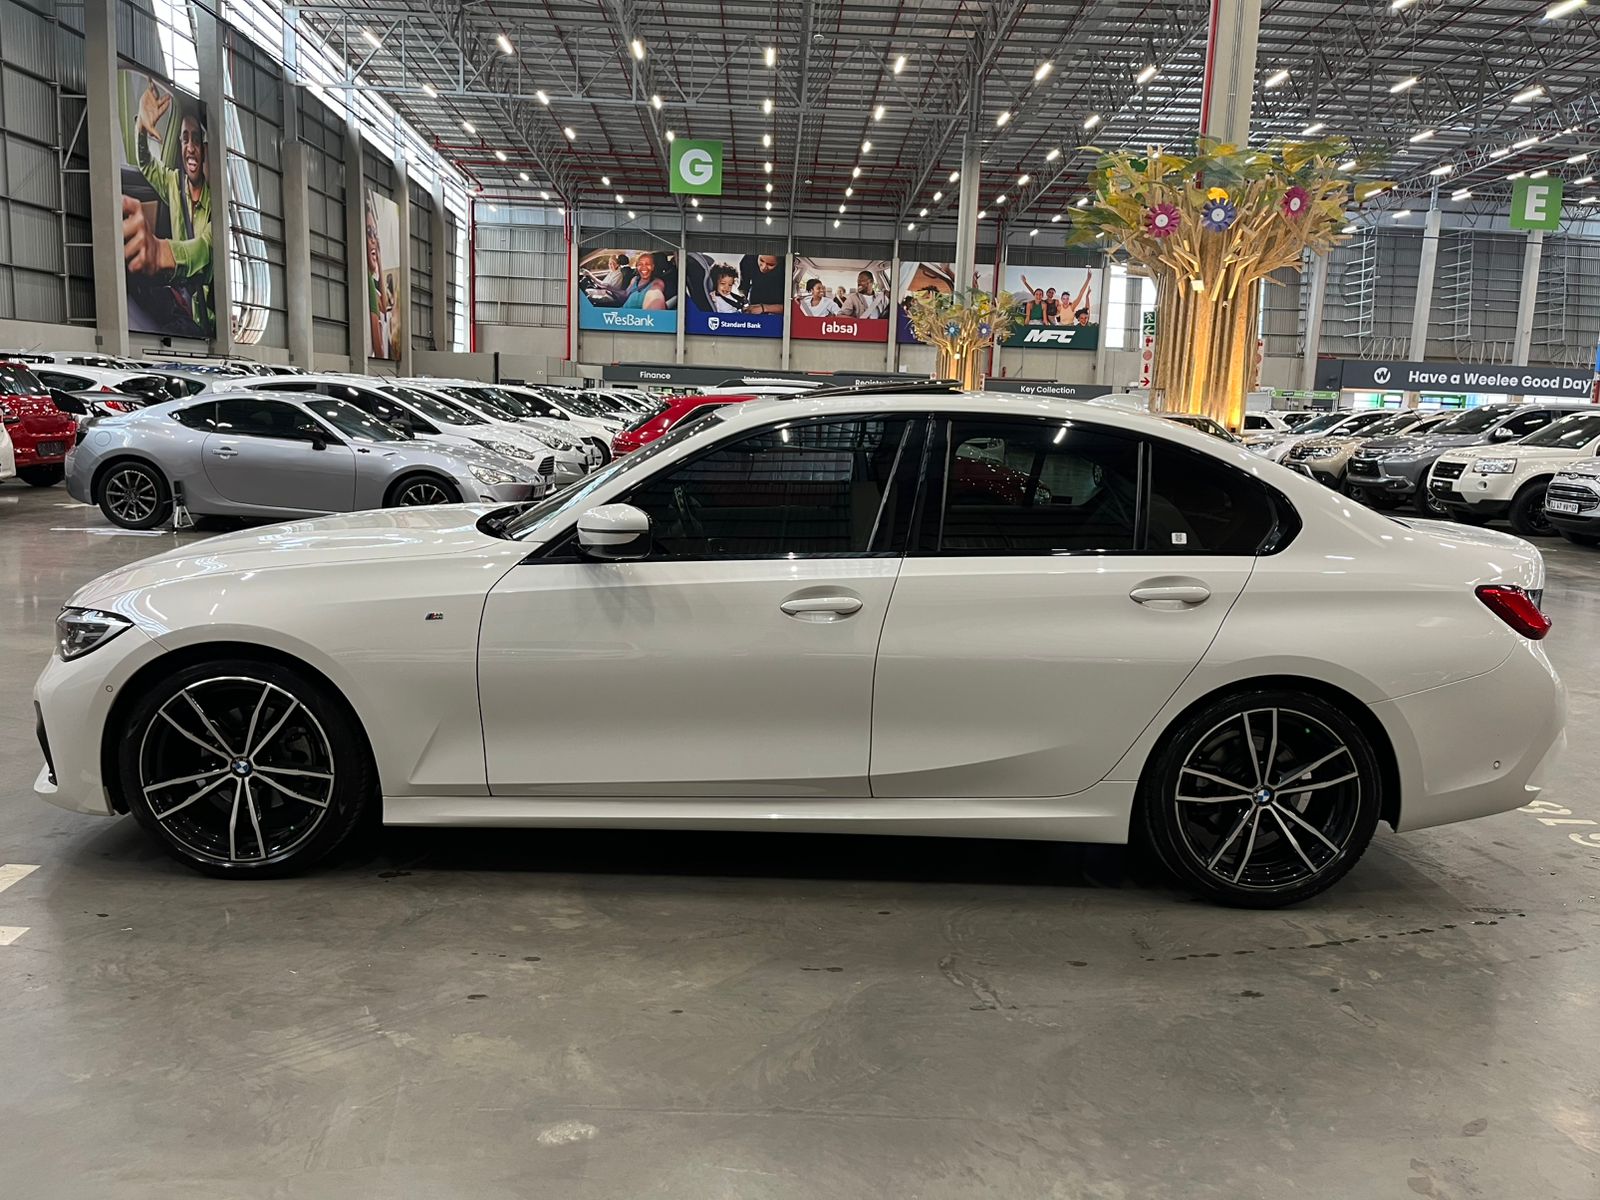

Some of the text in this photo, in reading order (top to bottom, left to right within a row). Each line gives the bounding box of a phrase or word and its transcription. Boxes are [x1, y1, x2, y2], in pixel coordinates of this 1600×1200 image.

[679, 149, 713, 185] G
[1524, 185, 1549, 221] E
[603, 312, 654, 327] WesBank
[720, 321, 746, 329] Standard
[821, 321, 857, 336] (absa)
[1023, 329, 1076, 344] MFC
[640, 370, 671, 379] Finance
[1408, 370, 1591, 394] Have a Weelee Good Day
[1020, 385, 1076, 394] Key Collection
